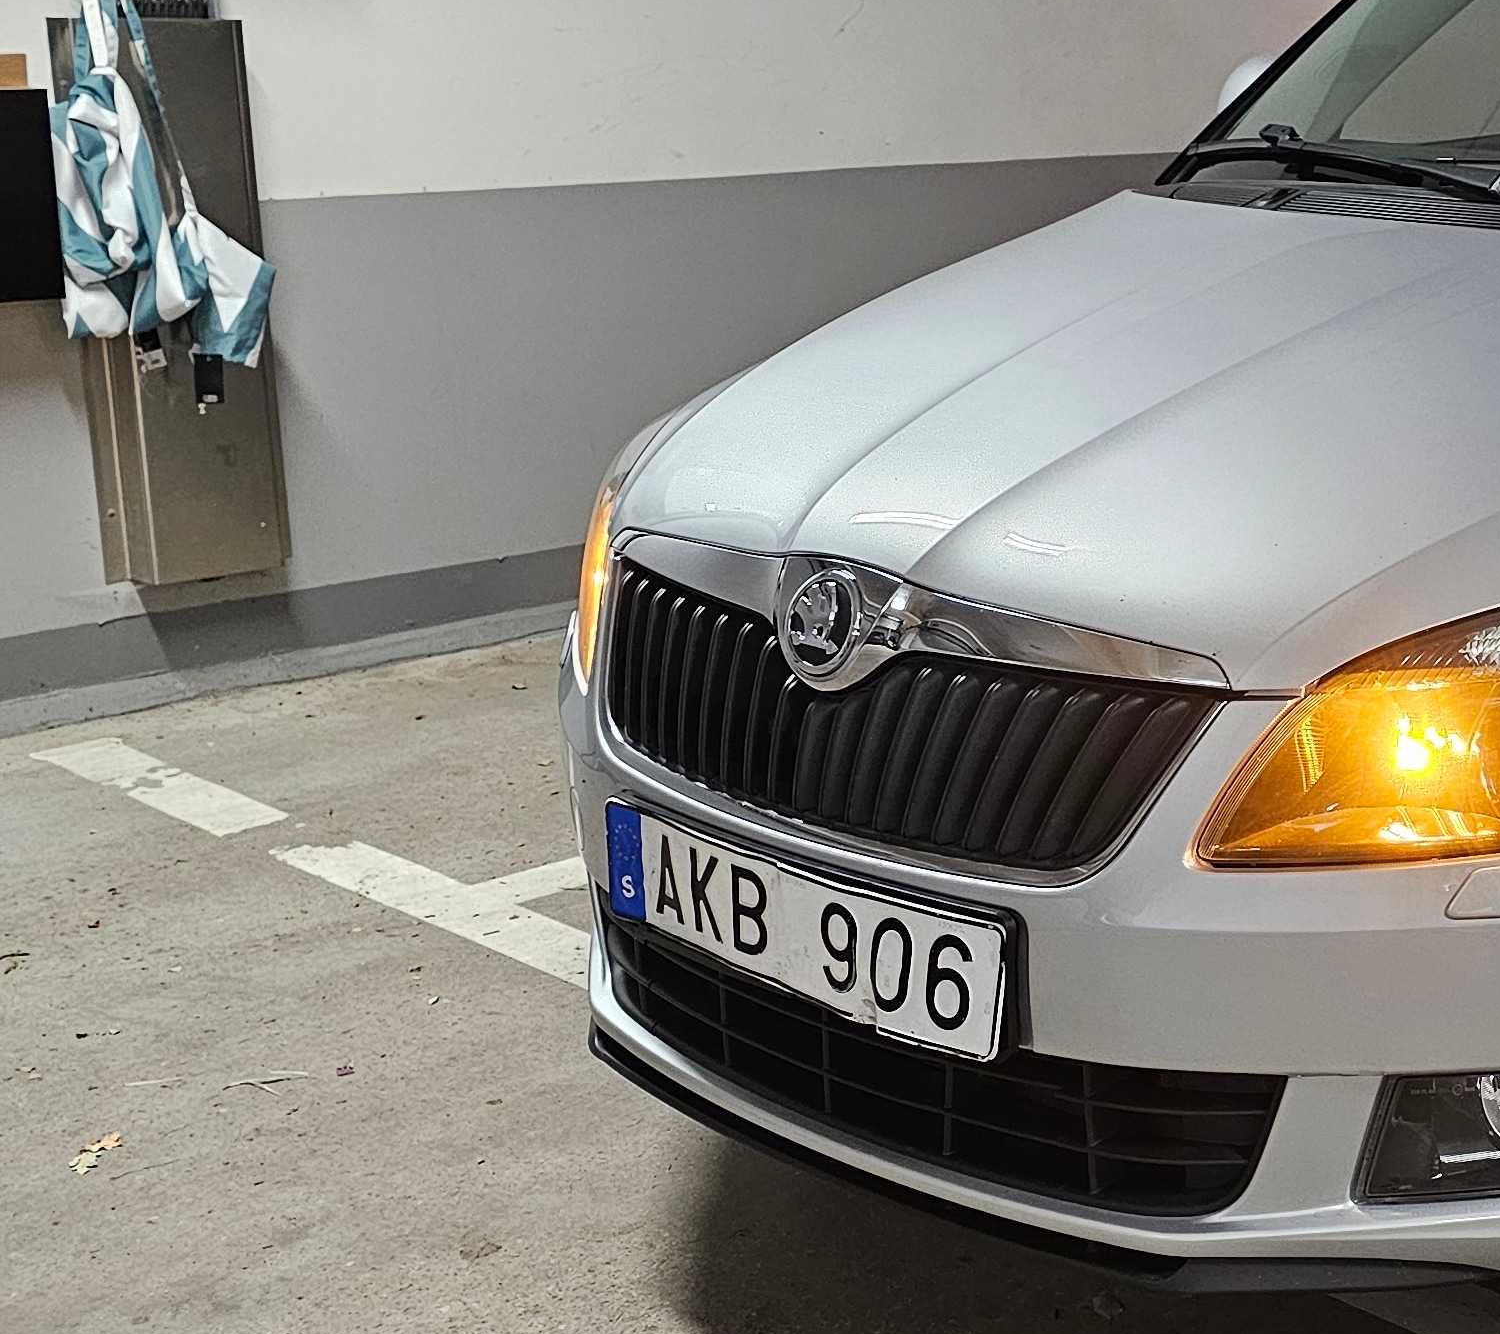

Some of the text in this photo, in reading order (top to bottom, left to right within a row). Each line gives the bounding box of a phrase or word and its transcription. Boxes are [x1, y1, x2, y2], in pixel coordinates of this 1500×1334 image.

[621, 874, 636, 899] S
[656, 834, 973, 1031] AKB 906
